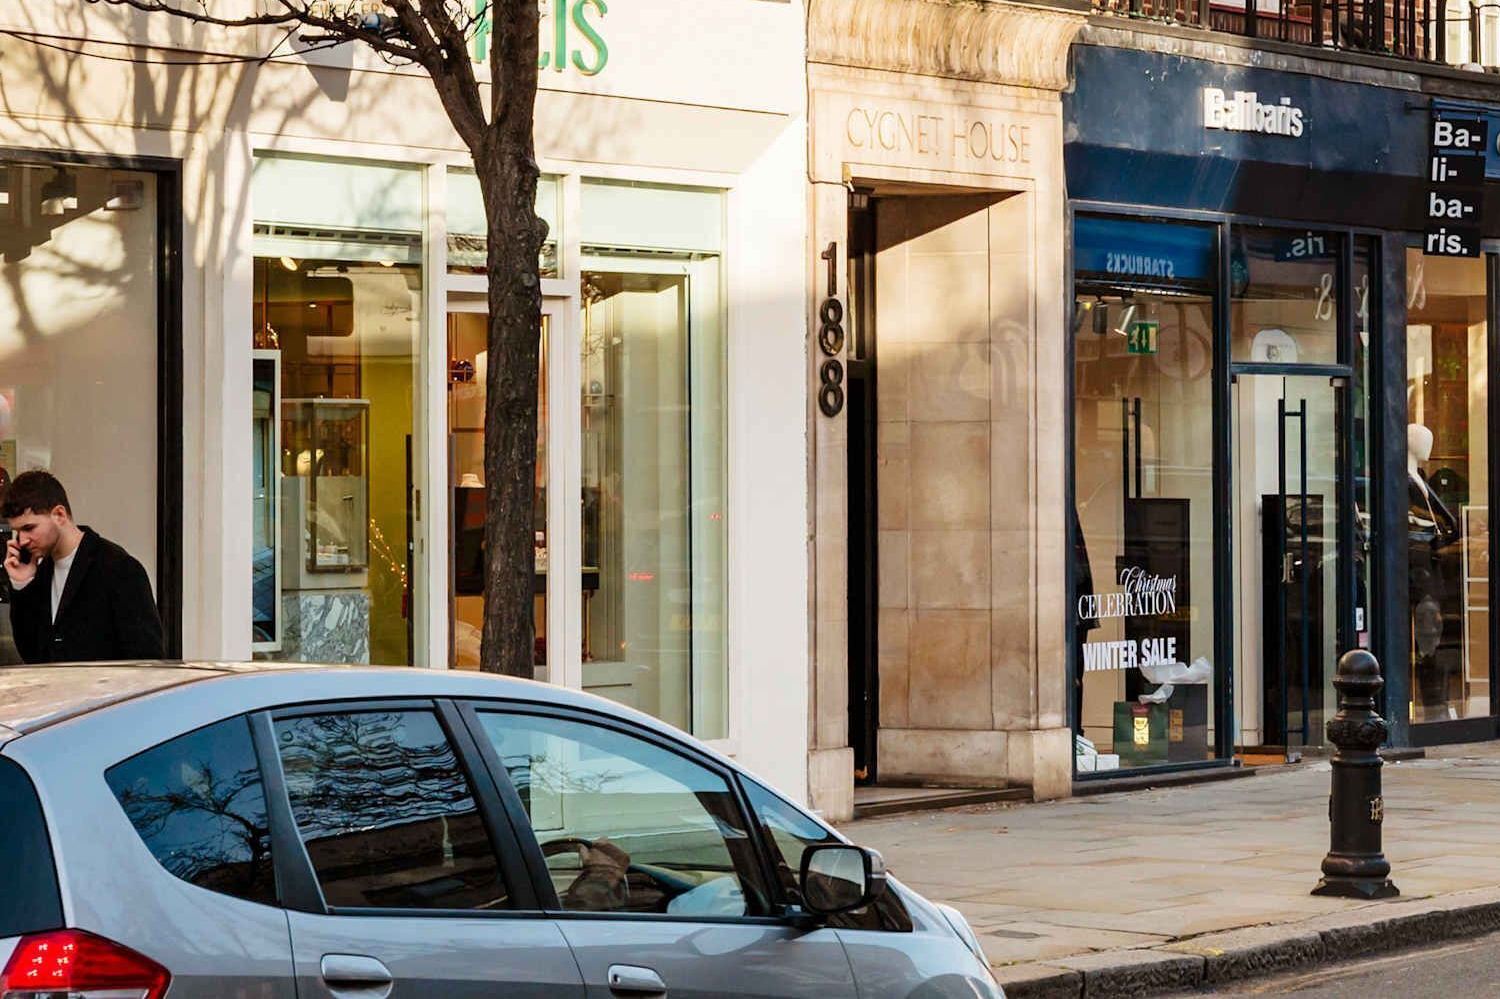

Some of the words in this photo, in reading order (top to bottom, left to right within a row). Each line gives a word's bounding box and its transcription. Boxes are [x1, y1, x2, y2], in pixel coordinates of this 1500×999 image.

[847, 107, 944, 157] CYGNET
[952, 118, 1031, 163] HOUSE
[1433, 120, 1481, 148] Ba-
[1431, 156, 1458, 182] li-
[1429, 192, 1474, 219] ba-
[1426, 227, 1468, 254] ris.
[818, 241, 845, 418] 188
[1120, 566, 1177, 593] Christmas
[1078, 590, 1177, 620] CELEBRATION
[1082, 639, 1138, 672] WINTER
[1141, 637, 1177, 667] SALE
